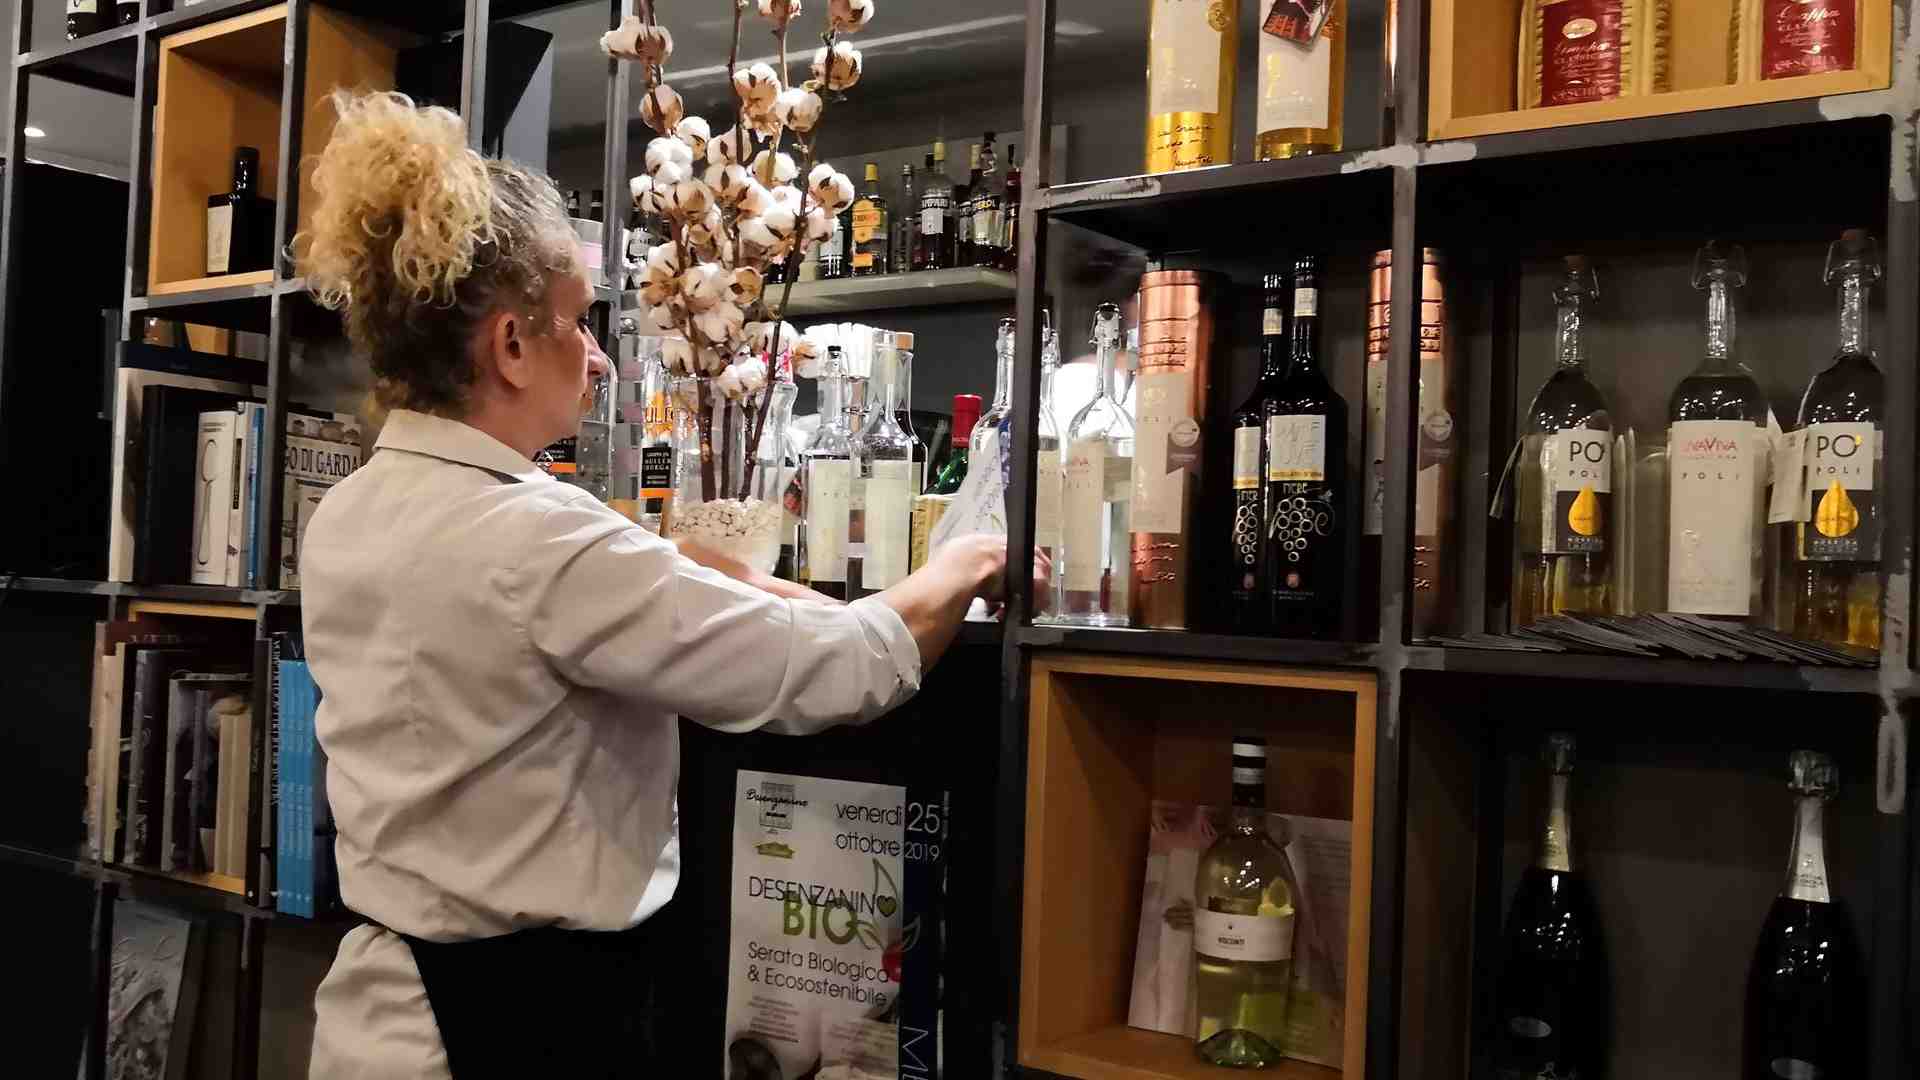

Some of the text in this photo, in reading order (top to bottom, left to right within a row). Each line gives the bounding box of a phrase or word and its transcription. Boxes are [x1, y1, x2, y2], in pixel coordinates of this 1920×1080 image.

[301, 448, 315, 473] DI
[316, 451, 360, 477] GARDA
[907, 802, 941, 834] 25
[836, 832, 940, 861] ottobre 2019
[783, 892, 858, 945] BIO
[748, 941, 889, 983] Serata Biologica
[747, 964, 888, 1007] & Ecosostenibile
[902, 1026, 929, 1080] M
